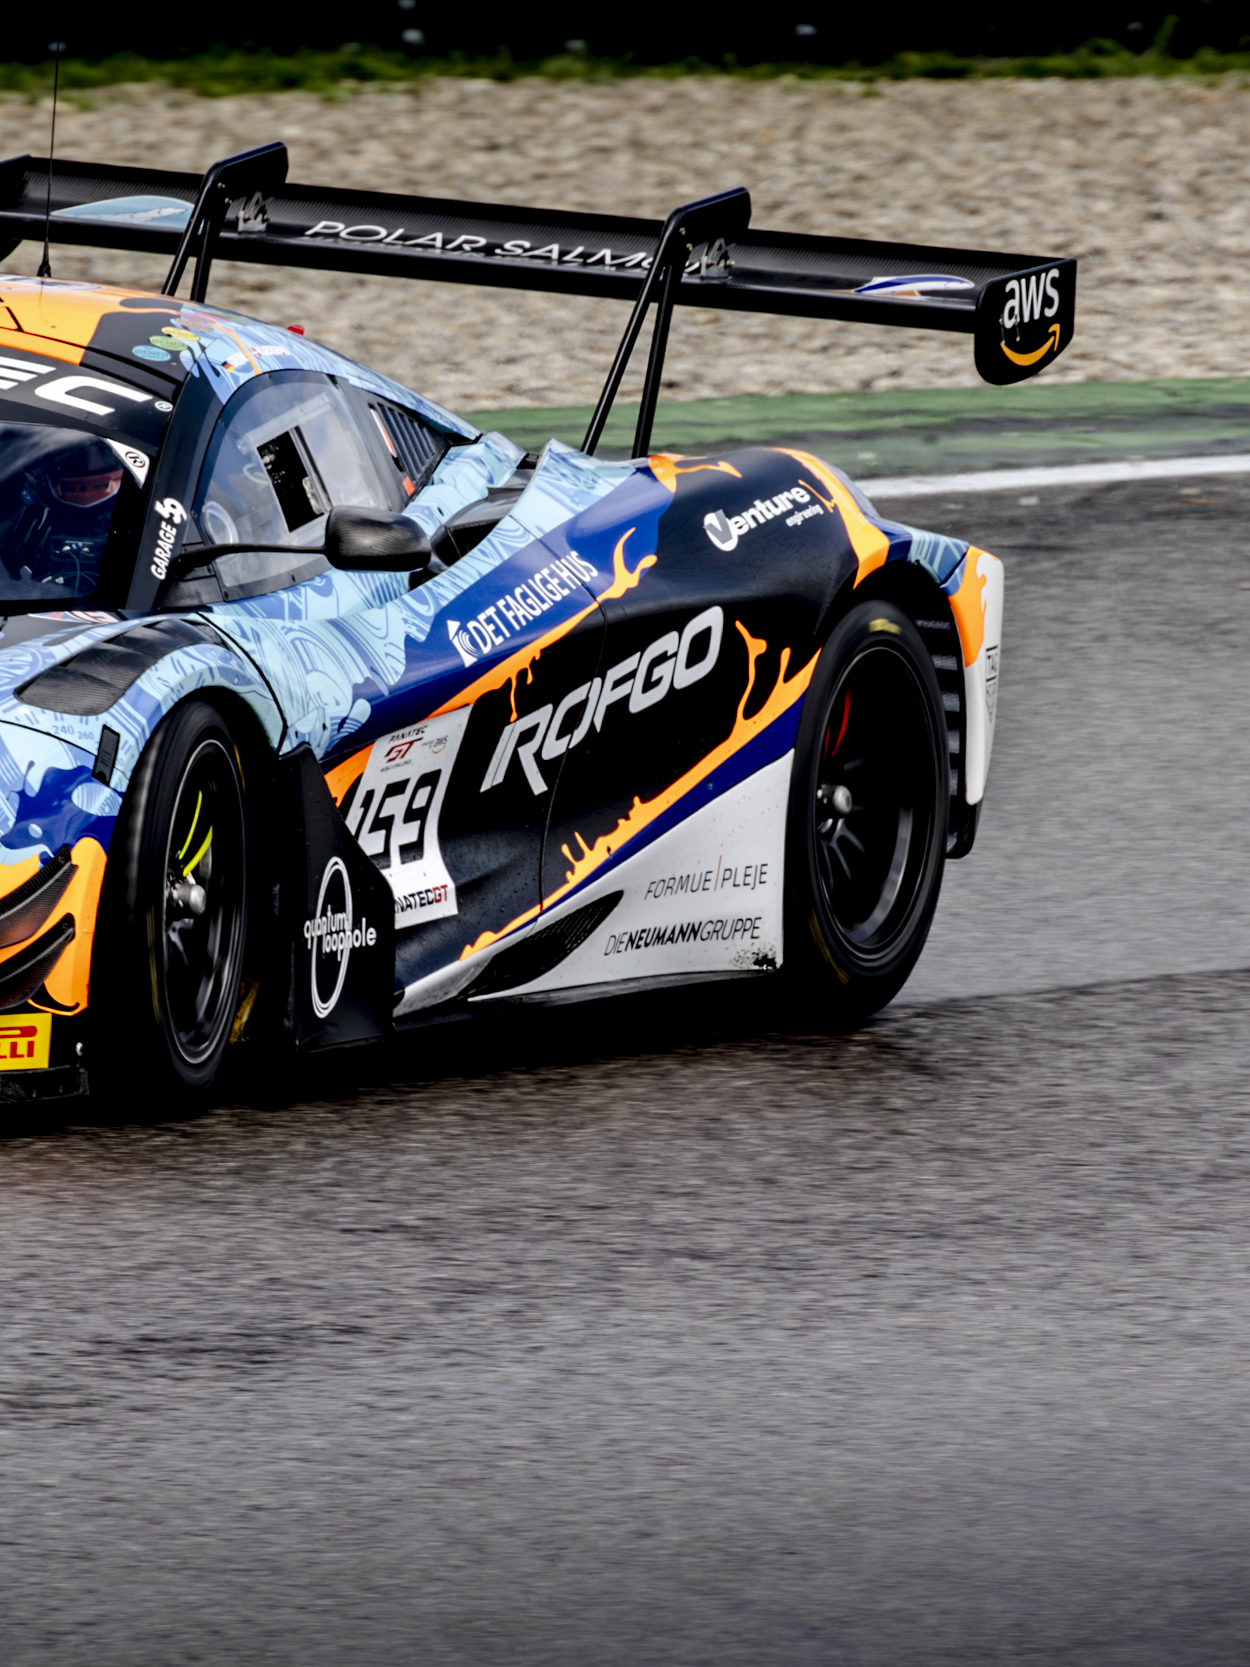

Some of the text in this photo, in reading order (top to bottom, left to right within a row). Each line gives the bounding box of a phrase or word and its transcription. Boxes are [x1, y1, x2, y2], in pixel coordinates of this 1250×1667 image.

[304, 220, 699, 273] POLAR SALM
[1003, 268, 1060, 329] aws
[704, 487, 811, 551] Venture
[150, 521, 177, 580] GARAGE
[466, 551, 598, 654] DET FAGLIGE HUS
[479, 605, 724, 796] ROFGO
[51, 724, 75, 736] 240
[353, 768, 442, 870] 159
[395, 884, 448, 914] NATECGT
[644, 863, 768, 900] FORMUE PLEJE
[304, 905, 348, 949] quantum
[323, 917, 377, 961] loophole
